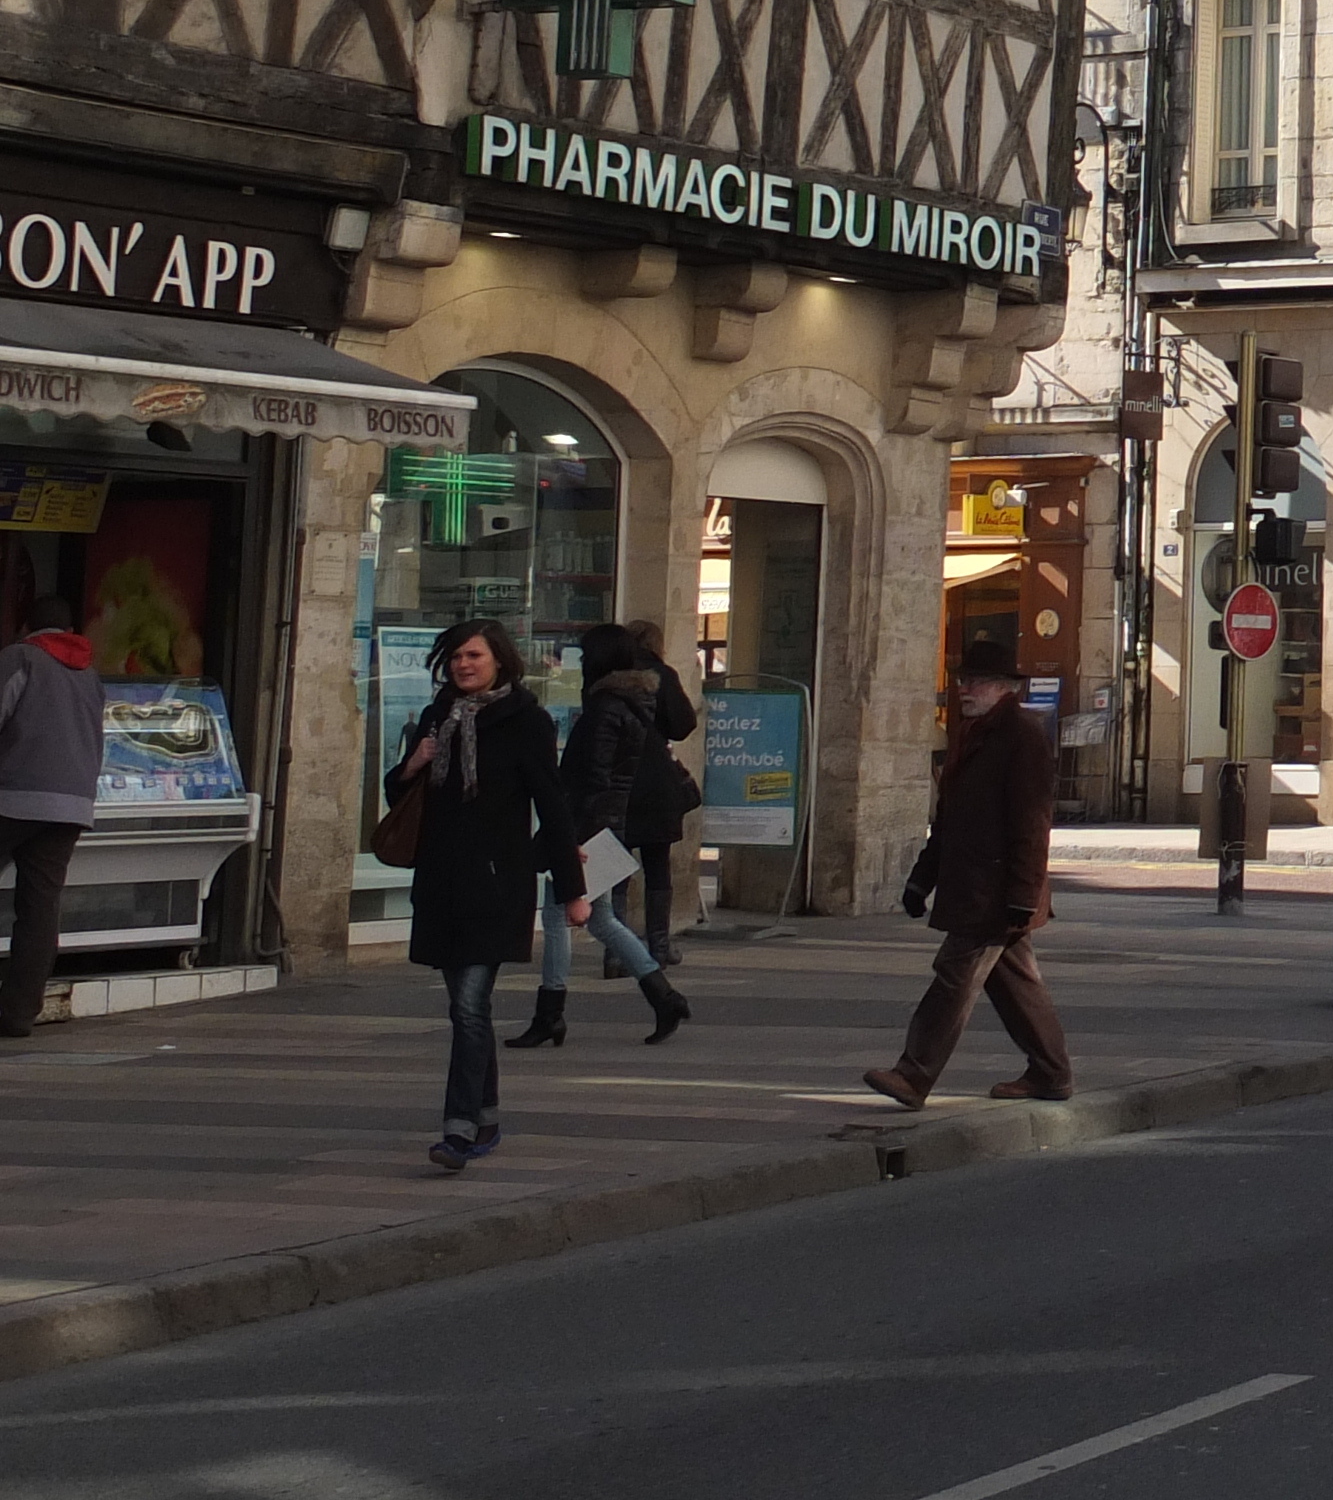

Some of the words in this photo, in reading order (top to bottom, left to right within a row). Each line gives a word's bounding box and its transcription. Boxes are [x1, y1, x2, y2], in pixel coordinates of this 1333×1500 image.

[481, 114, 791, 233] PHARMACIE
[810, 183, 876, 248] DU
[891, 198, 1043, 277] MIROIR
[0, 213, 144, 298] ON'
[152, 234, 276, 315] APP
[253, 397, 318, 427] KEBAB
[1125, 396, 1163, 413] minelli
[367, 407, 456, 438] BOISSON
